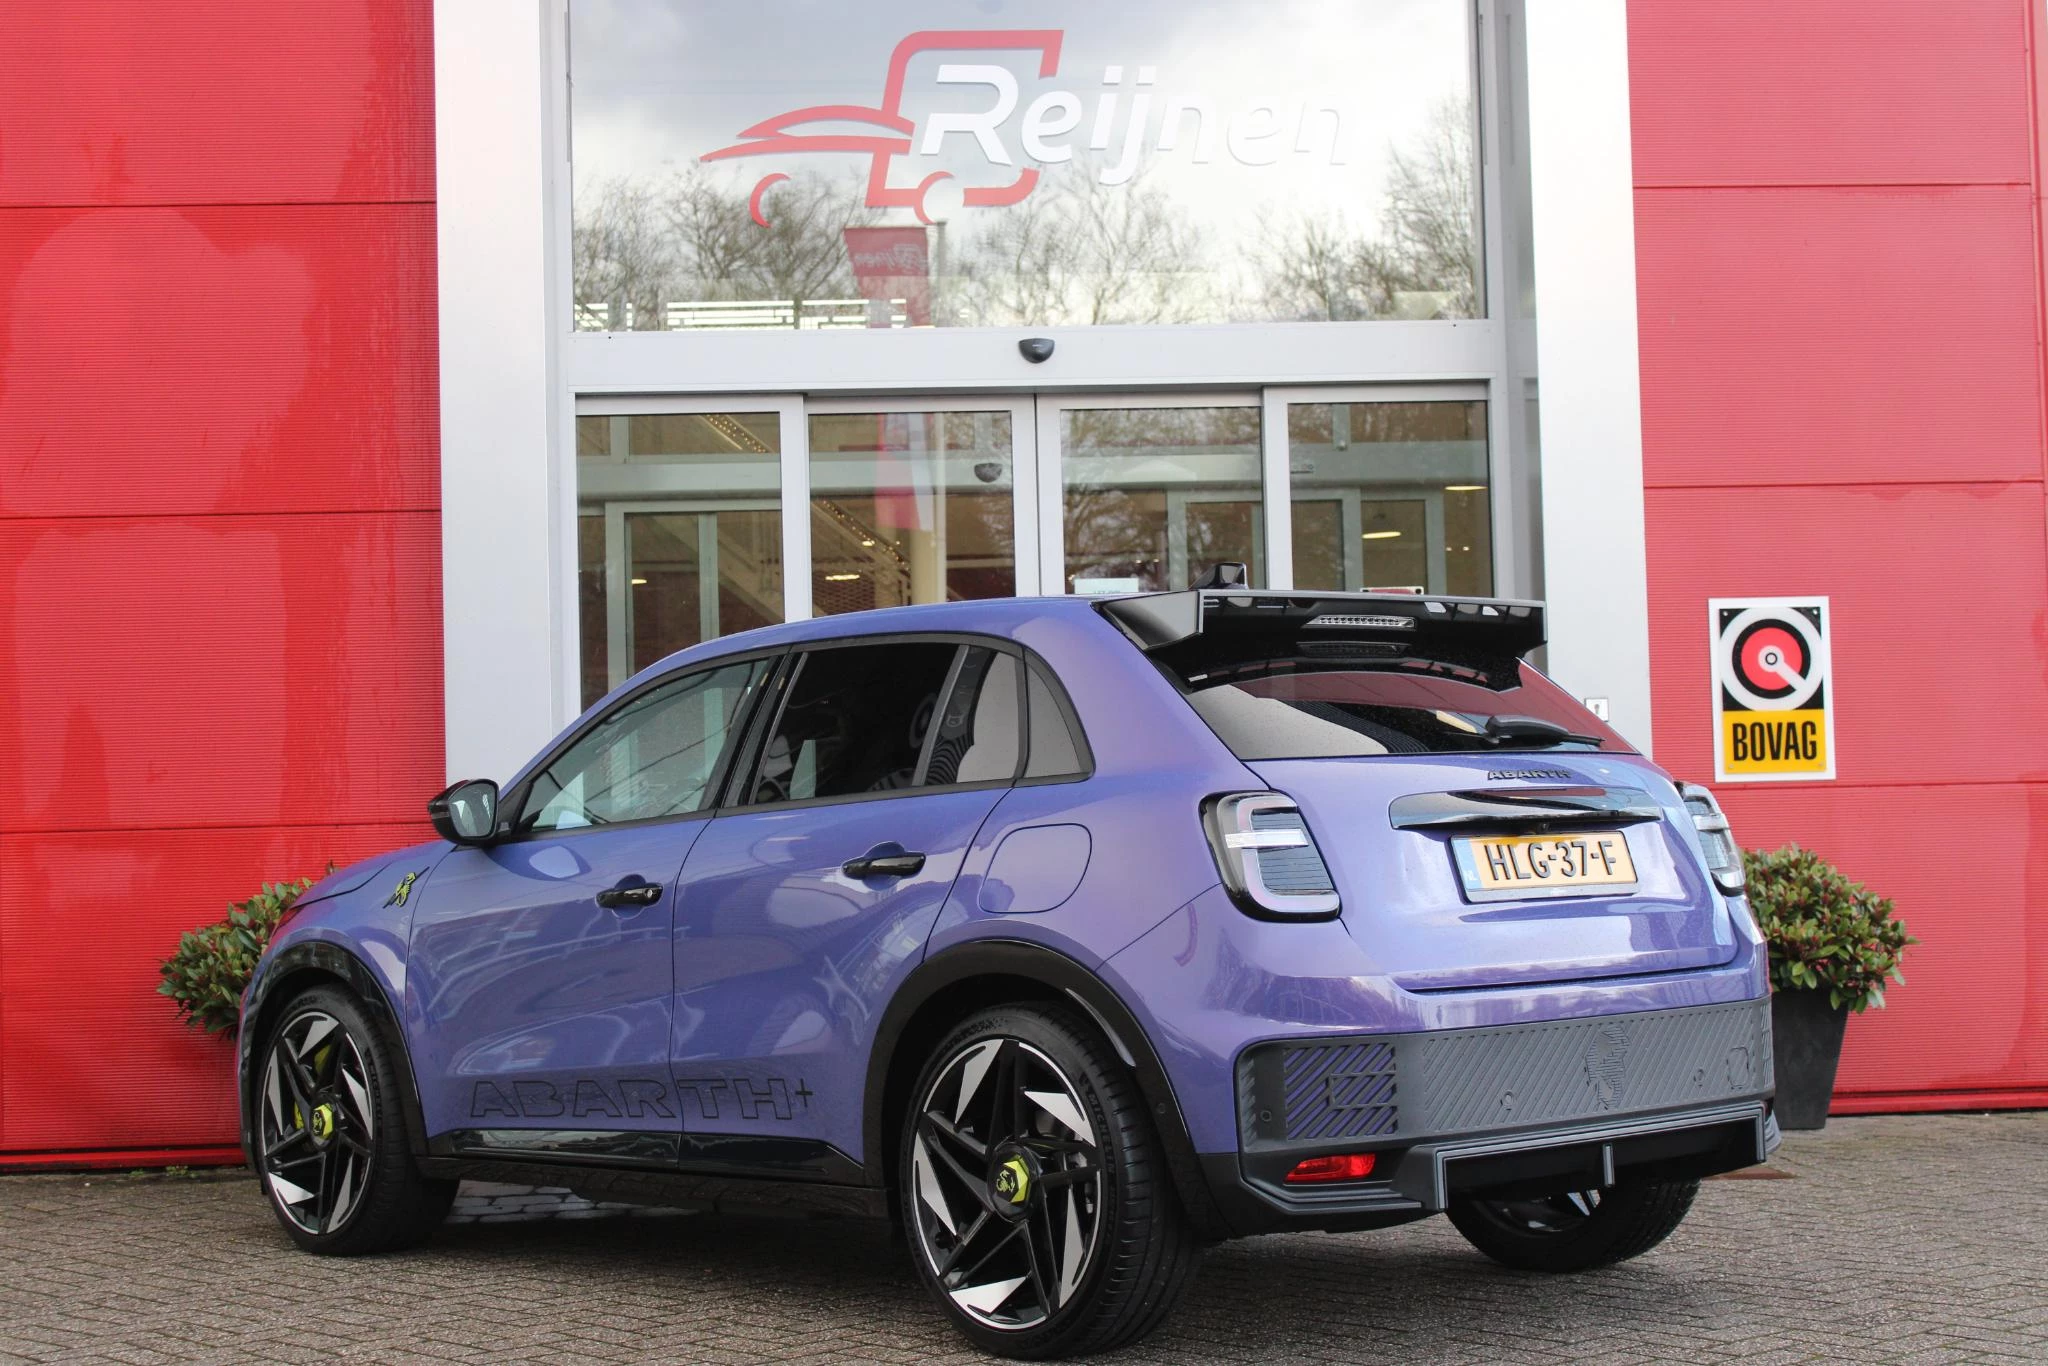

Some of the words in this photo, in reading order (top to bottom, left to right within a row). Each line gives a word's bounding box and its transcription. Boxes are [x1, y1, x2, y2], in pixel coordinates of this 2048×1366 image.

[919, 63, 1347, 187] Reijnen
[1732, 720, 1817, 762] BOVAG
[1487, 769, 1572, 781] ABARTH
[1484, 840, 1617, 881] HLG-37-F
